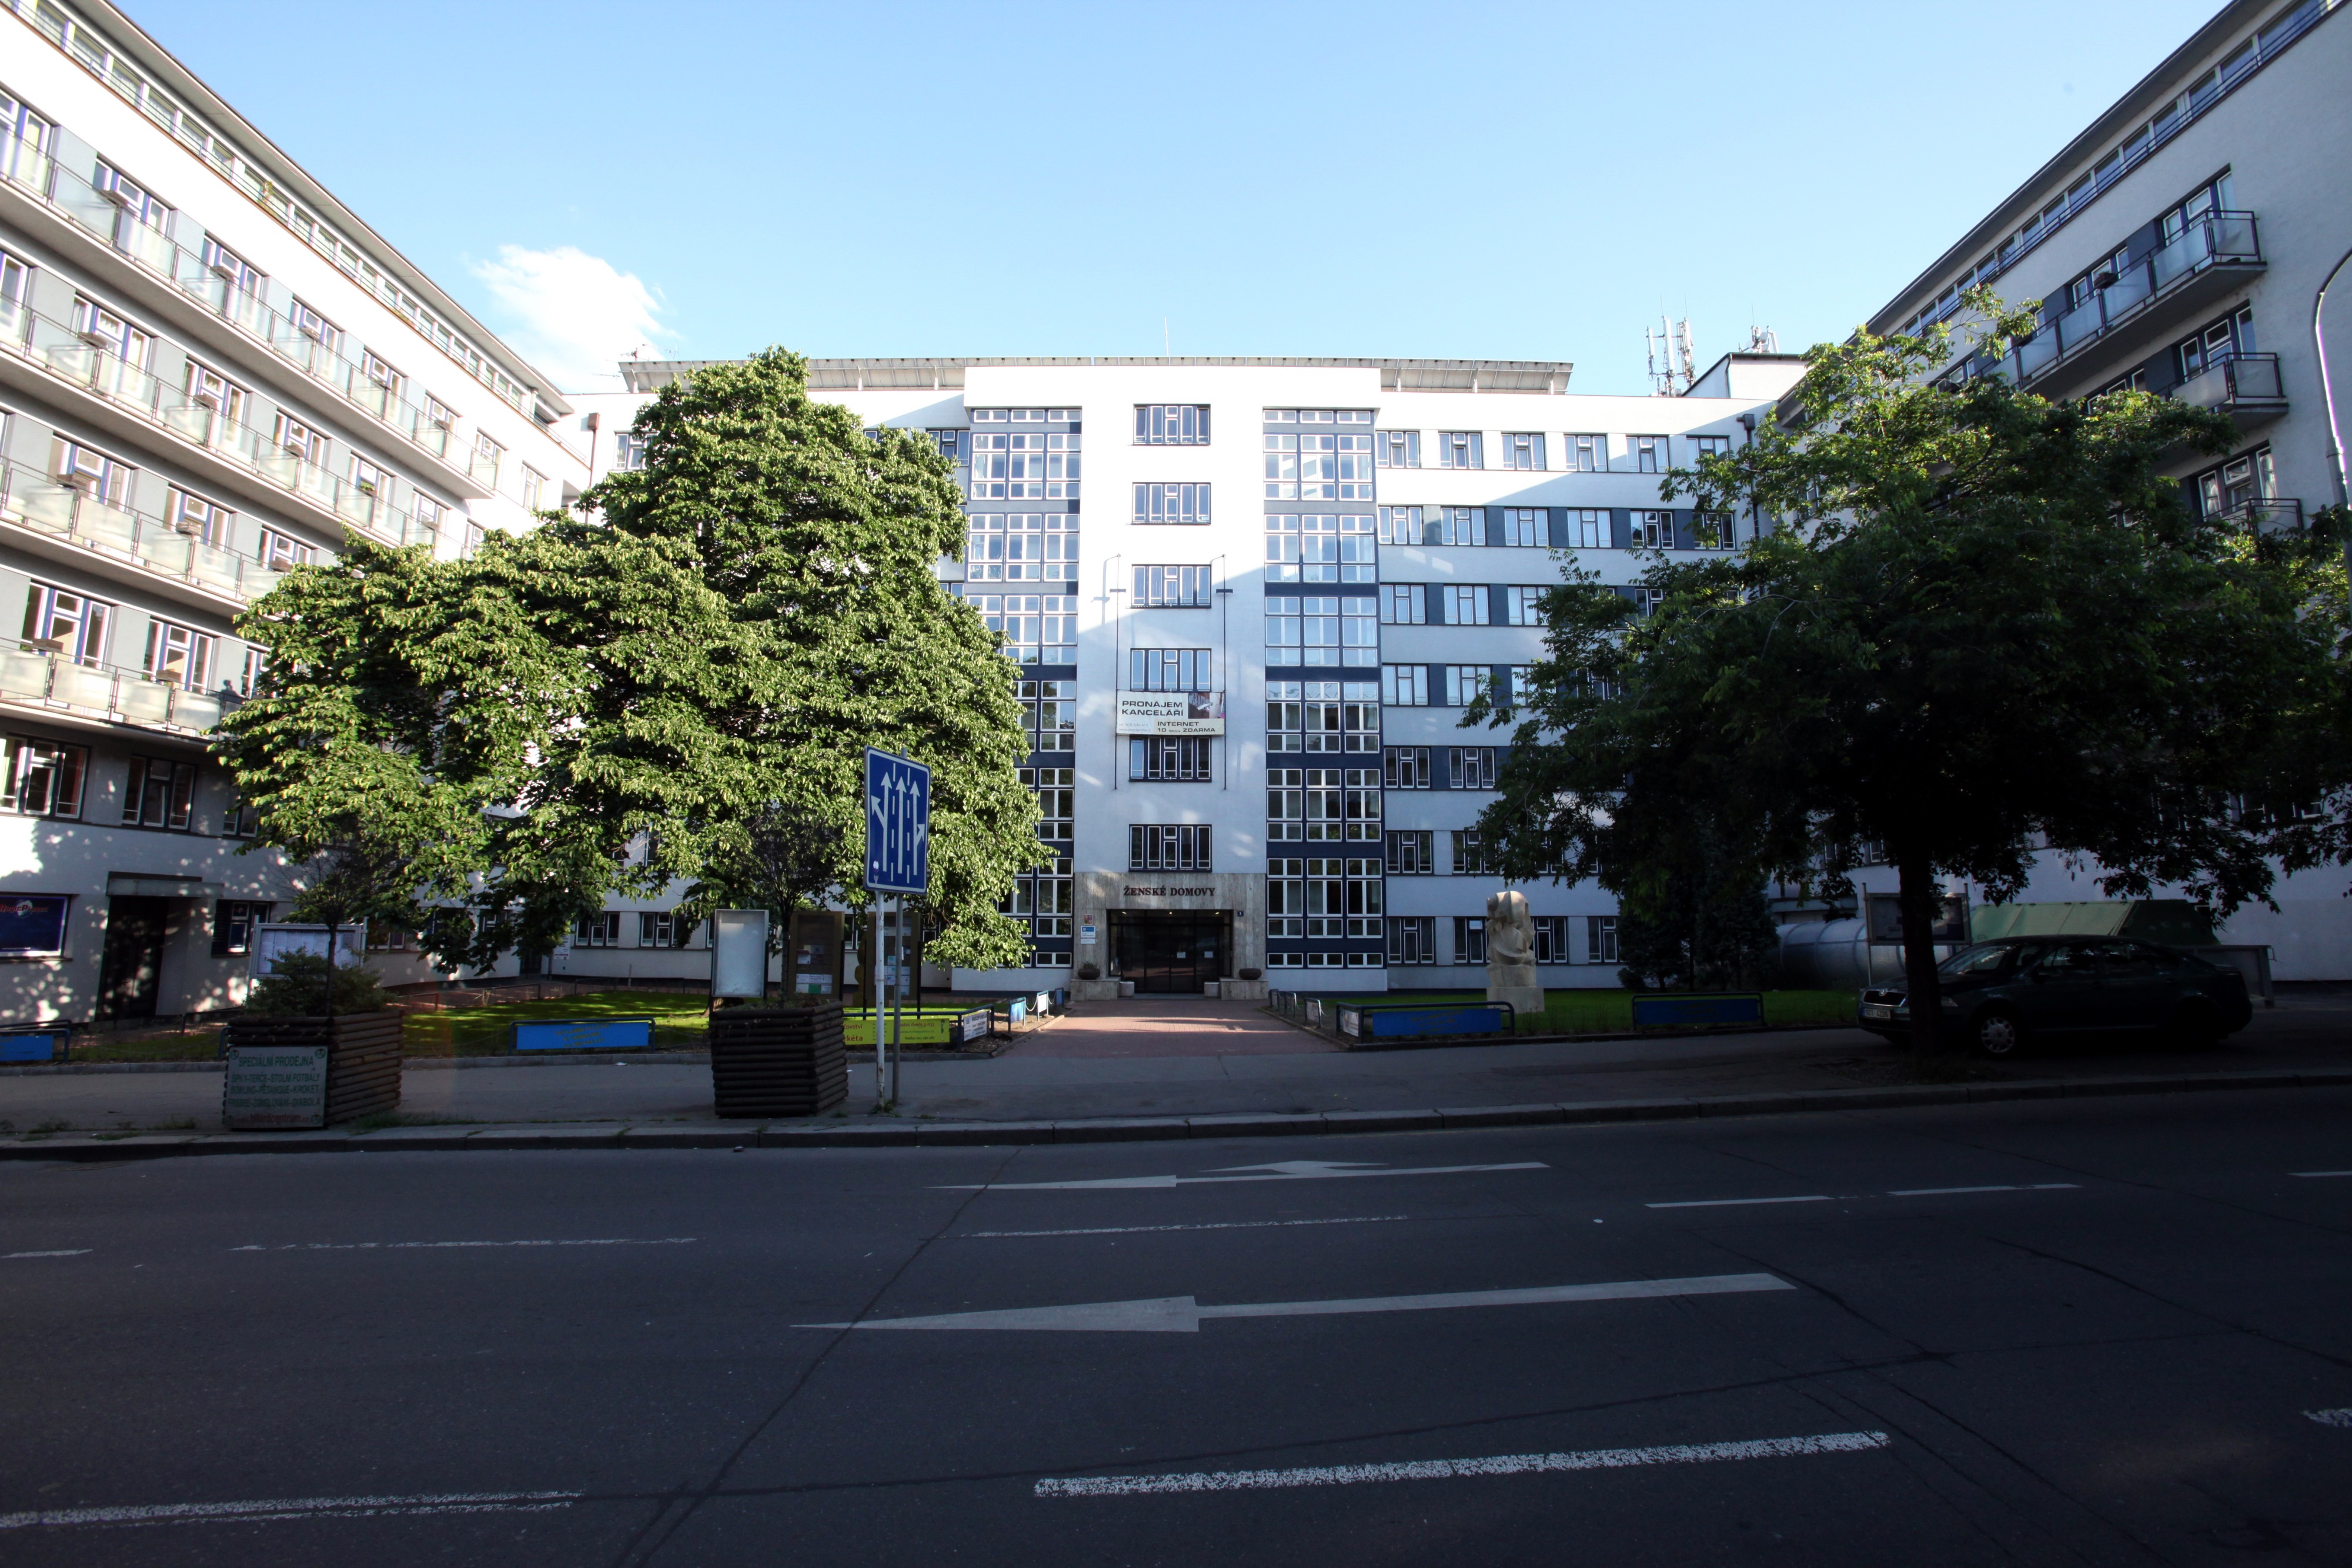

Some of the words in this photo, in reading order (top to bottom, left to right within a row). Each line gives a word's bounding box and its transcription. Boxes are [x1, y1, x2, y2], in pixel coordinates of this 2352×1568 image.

[1124, 885, 1166, 895] ŽENSKÉ
[1170, 888, 1215, 896] DOMOVY
[238, 1054, 273, 1066] SPECIÁLNÍ
[275, 1056, 313, 1066] PRODEJNA
[293, 1073, 320, 1082] FOTBALY
